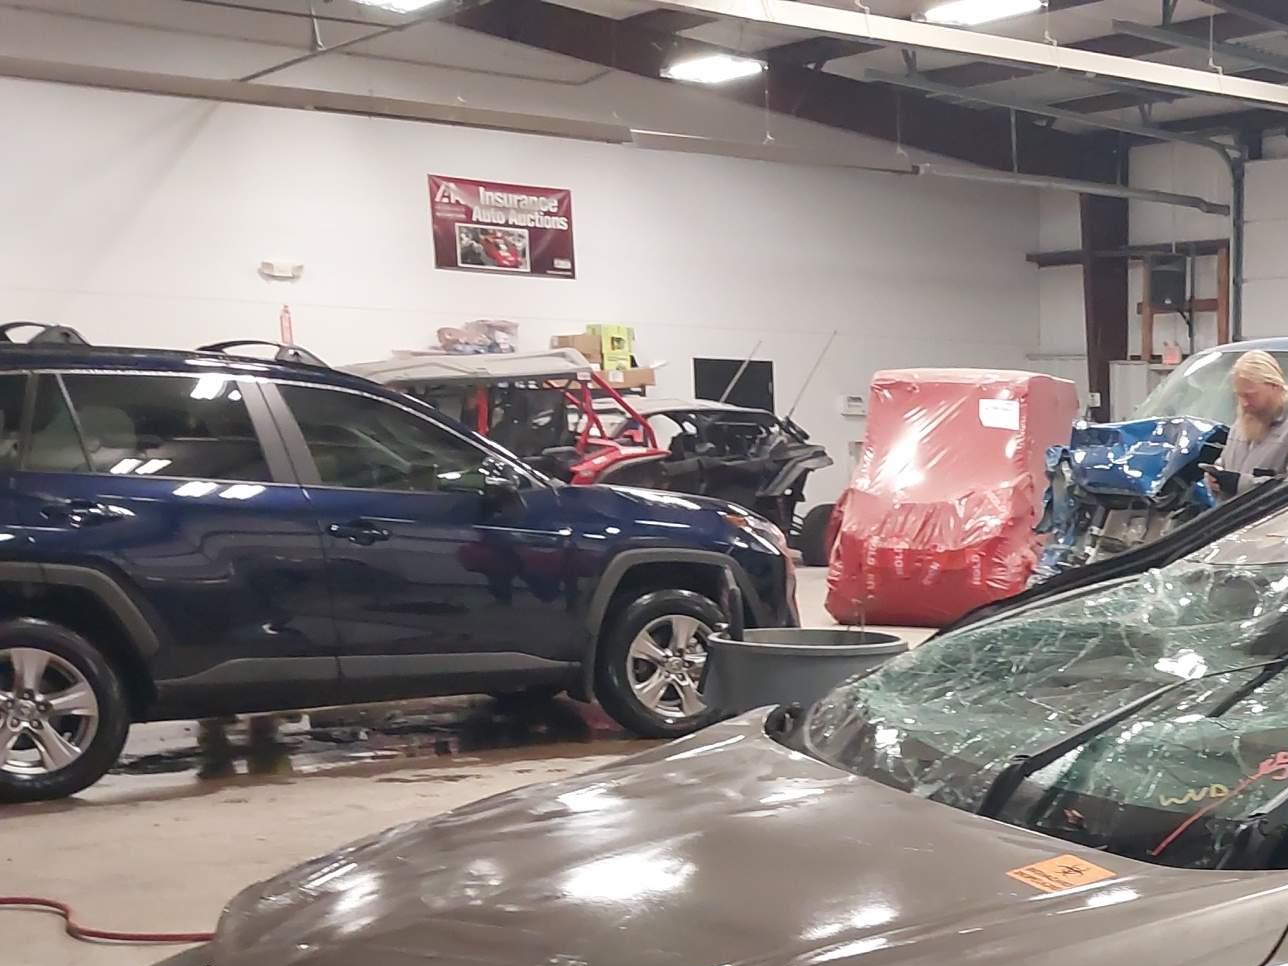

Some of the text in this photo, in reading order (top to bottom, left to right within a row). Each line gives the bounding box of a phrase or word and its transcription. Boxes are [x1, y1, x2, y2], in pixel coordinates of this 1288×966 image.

[478, 186, 559, 213] Insurance
[472, 205, 506, 225] Auto
[508, 209, 569, 231] Auctions
